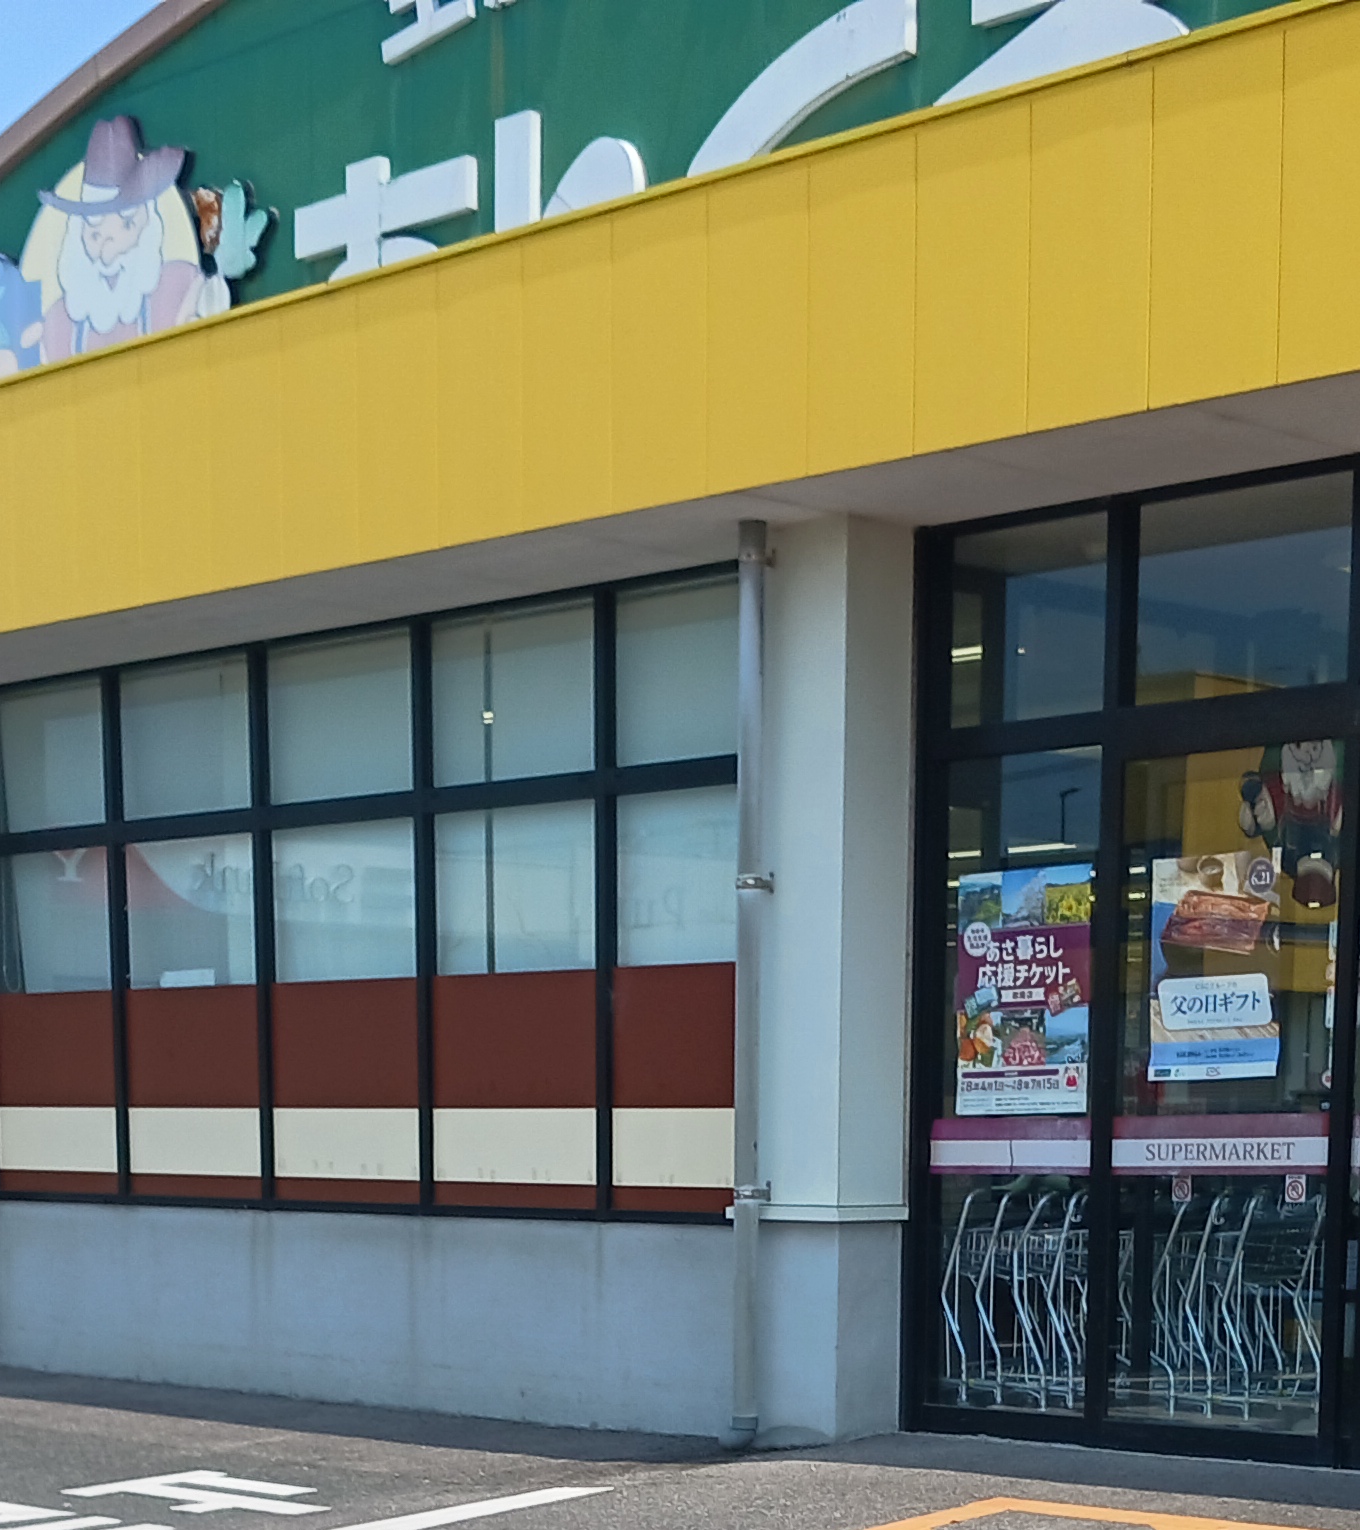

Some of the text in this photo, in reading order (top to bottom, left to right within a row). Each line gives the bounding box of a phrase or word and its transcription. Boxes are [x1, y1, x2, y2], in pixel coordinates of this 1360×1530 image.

[986, 935, 1063, 962] あさ暮らし
[977, 961, 1070, 988] 応援チケット
[1170, 990, 1260, 1016] 父の日ギフト
[1145, 1142, 1296, 1162] SUPERMARKET
